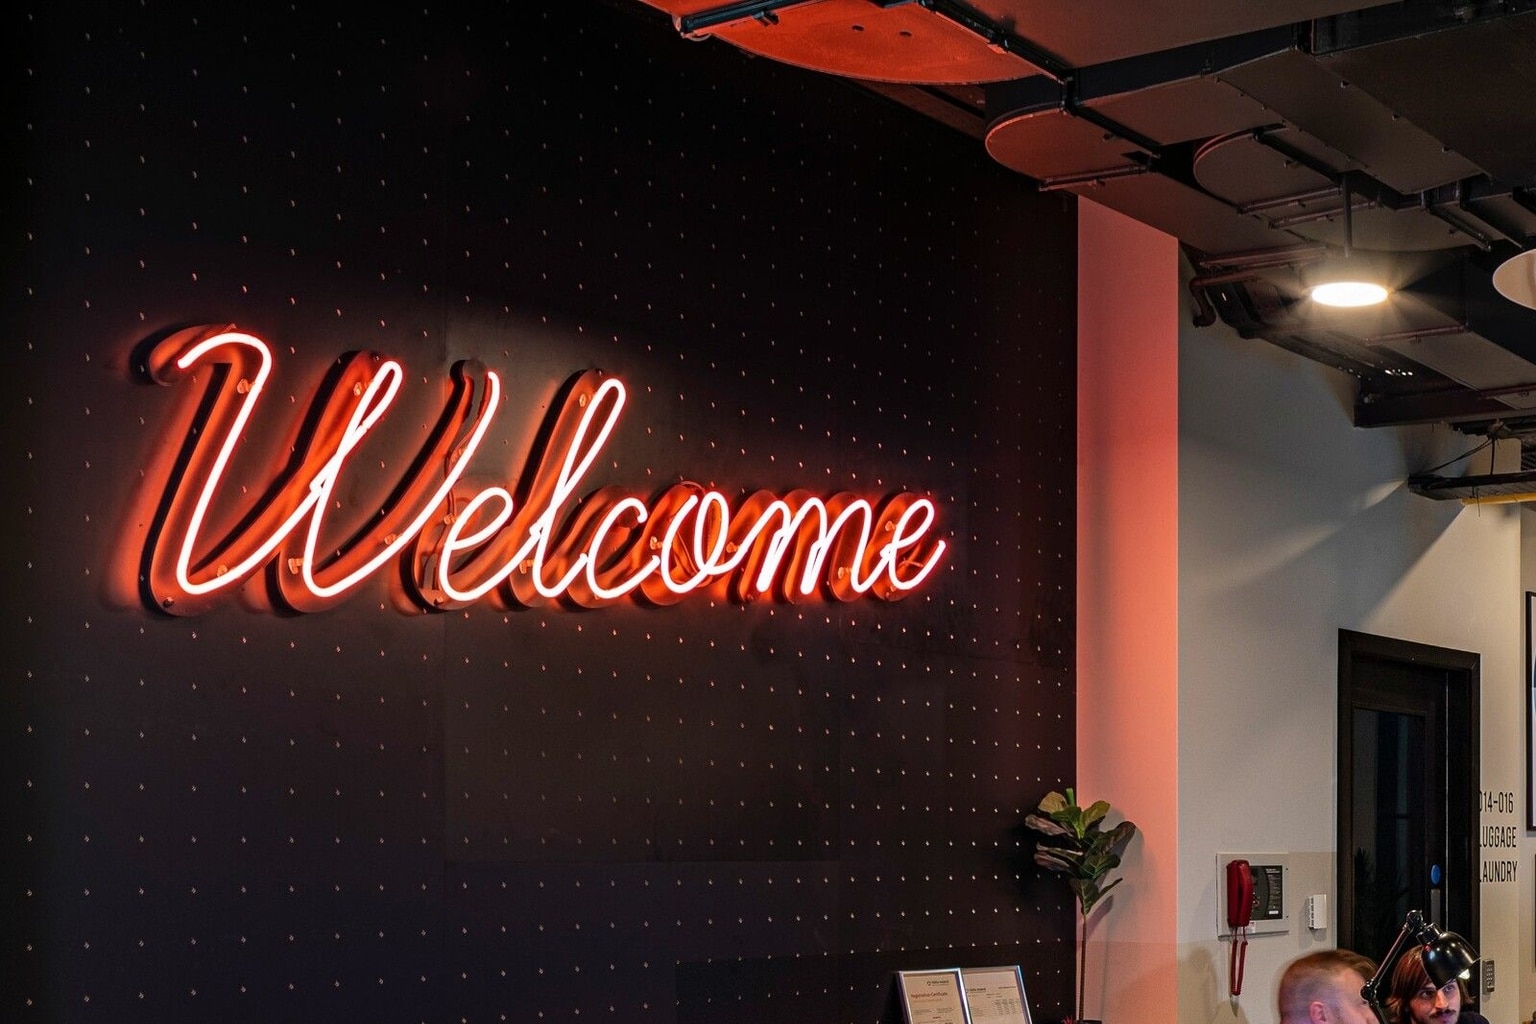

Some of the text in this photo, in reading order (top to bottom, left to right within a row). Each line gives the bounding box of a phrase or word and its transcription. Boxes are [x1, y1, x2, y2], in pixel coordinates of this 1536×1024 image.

[176, 331, 946, 600] Welcome
[1480, 826, 1517, 848] UGGAGE
[1480, 861, 1518, 883] AUNDRY
